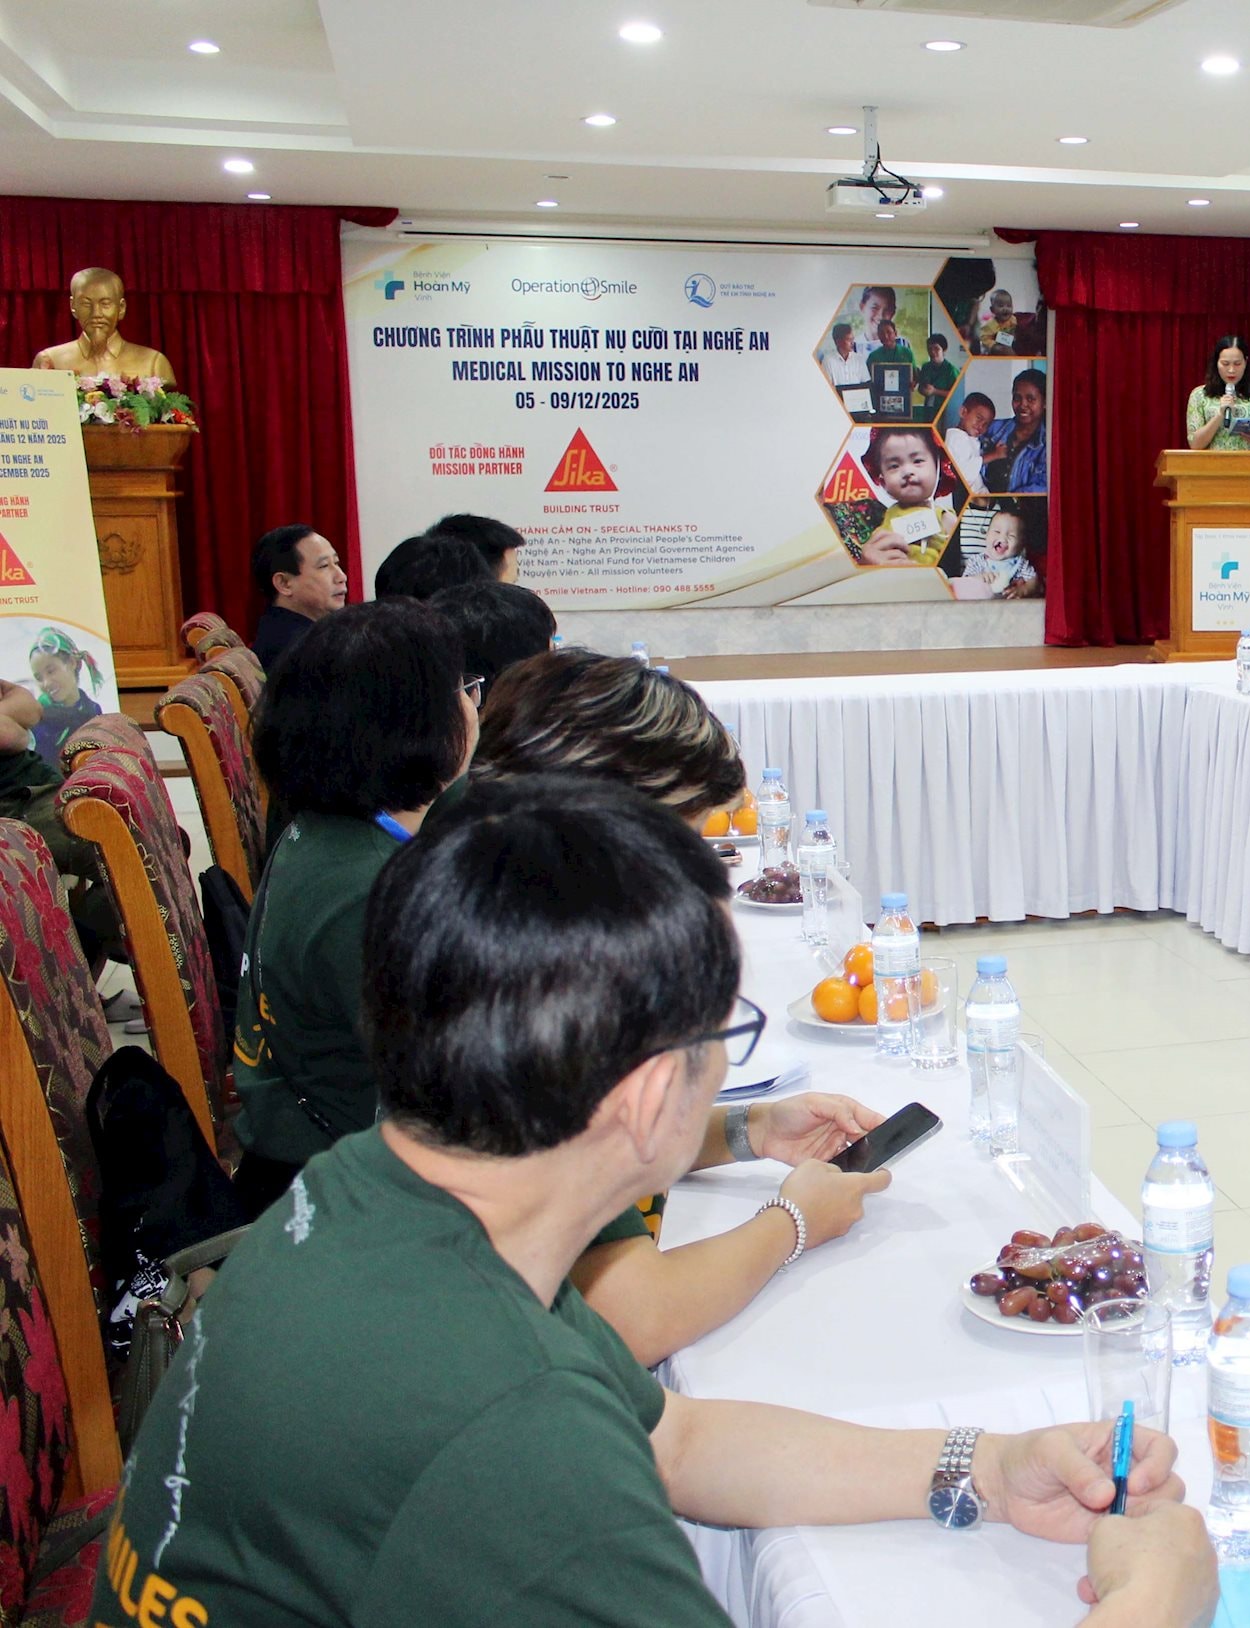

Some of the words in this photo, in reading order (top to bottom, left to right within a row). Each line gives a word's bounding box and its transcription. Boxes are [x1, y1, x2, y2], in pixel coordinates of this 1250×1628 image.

[414, 280, 449, 292] Hoàn
[451, 281, 471, 294] Mỹ
[511, 278, 580, 296] Operation
[600, 280, 638, 295] Smile
[373, 326, 441, 348] CHƯƠNG
[446, 324, 495, 348] TRÌNH
[500, 321, 544, 349] PHẪU
[549, 325, 600, 353] THUẬT
[605, 329, 627, 353] NỤ
[632, 325, 668, 350] CƯỜI
[673, 330, 697, 354] TẠI
[703, 327, 745, 354] NGHỆ
[749, 331, 770, 351] AN
[452, 361, 526, 381] MEDICAL
[532, 361, 601, 382] MISSION
[606, 362, 626, 382] TO
[632, 362, 673, 382] NGHE
[678, 362, 699, 382] AN
[515, 391, 535, 409] 05
[550, 391, 640, 410] 09/12/2025
[0, 417, 17, 431] HUẬT
[17, 434, 26, 444] 12
[47, 434, 67, 444] 2025
[429, 442, 446, 459] ĐỐI
[448, 445, 467, 459] TÁC
[470, 442, 496, 459] ĐỒNG
[499, 444, 525, 459] HÀNH
[1, 454, 11, 465] TO
[12, 454, 32, 465] NGHE
[33, 454, 44, 464] AN
[0, 468, 29, 478] CEMBER
[30, 468, 50, 478] 2025
[432, 462, 476, 476] MISSION
[479, 462, 523, 475] PARTNER
[553, 449, 607, 487] Sika
[824, 468, 870, 503] Sika
[0, 508, 29, 518] ARTNER
[543, 504, 588, 514] BUILDING
[590, 504, 620, 513] TRUST
[600, 525, 641, 534] SPECIAL
[643, 525, 683, 533] THANKS
[685, 524, 698, 532] TO
[568, 537, 592, 545] Nghe
[656, 535, 692, 545] People's
[573, 548, 596, 556] Nghe
[614, 546, 657, 554] Provincial
[659, 545, 713, 553] Government
[716, 545, 755, 554] Agencies
[607, 557, 629, 565] Fund
[646, 556, 697, 564] Vietnamese
[700, 555, 736, 563] Children
[587, 568, 599, 576] All
[637, 567, 684, 575] volunteers
[544, 587, 569, 595] Smile
[571, 587, 607, 595] Vietnam
[616, 586, 650, 594] Hotline:
[653, 585, 671, 593] 090
[674, 585, 691, 593] 488
[694, 584, 715, 592] 5555
[14, 595, 39, 605] TRUST
[1200, 591, 1231, 602] Hoàn
[1233, 591, 1250, 603] Mỹ
